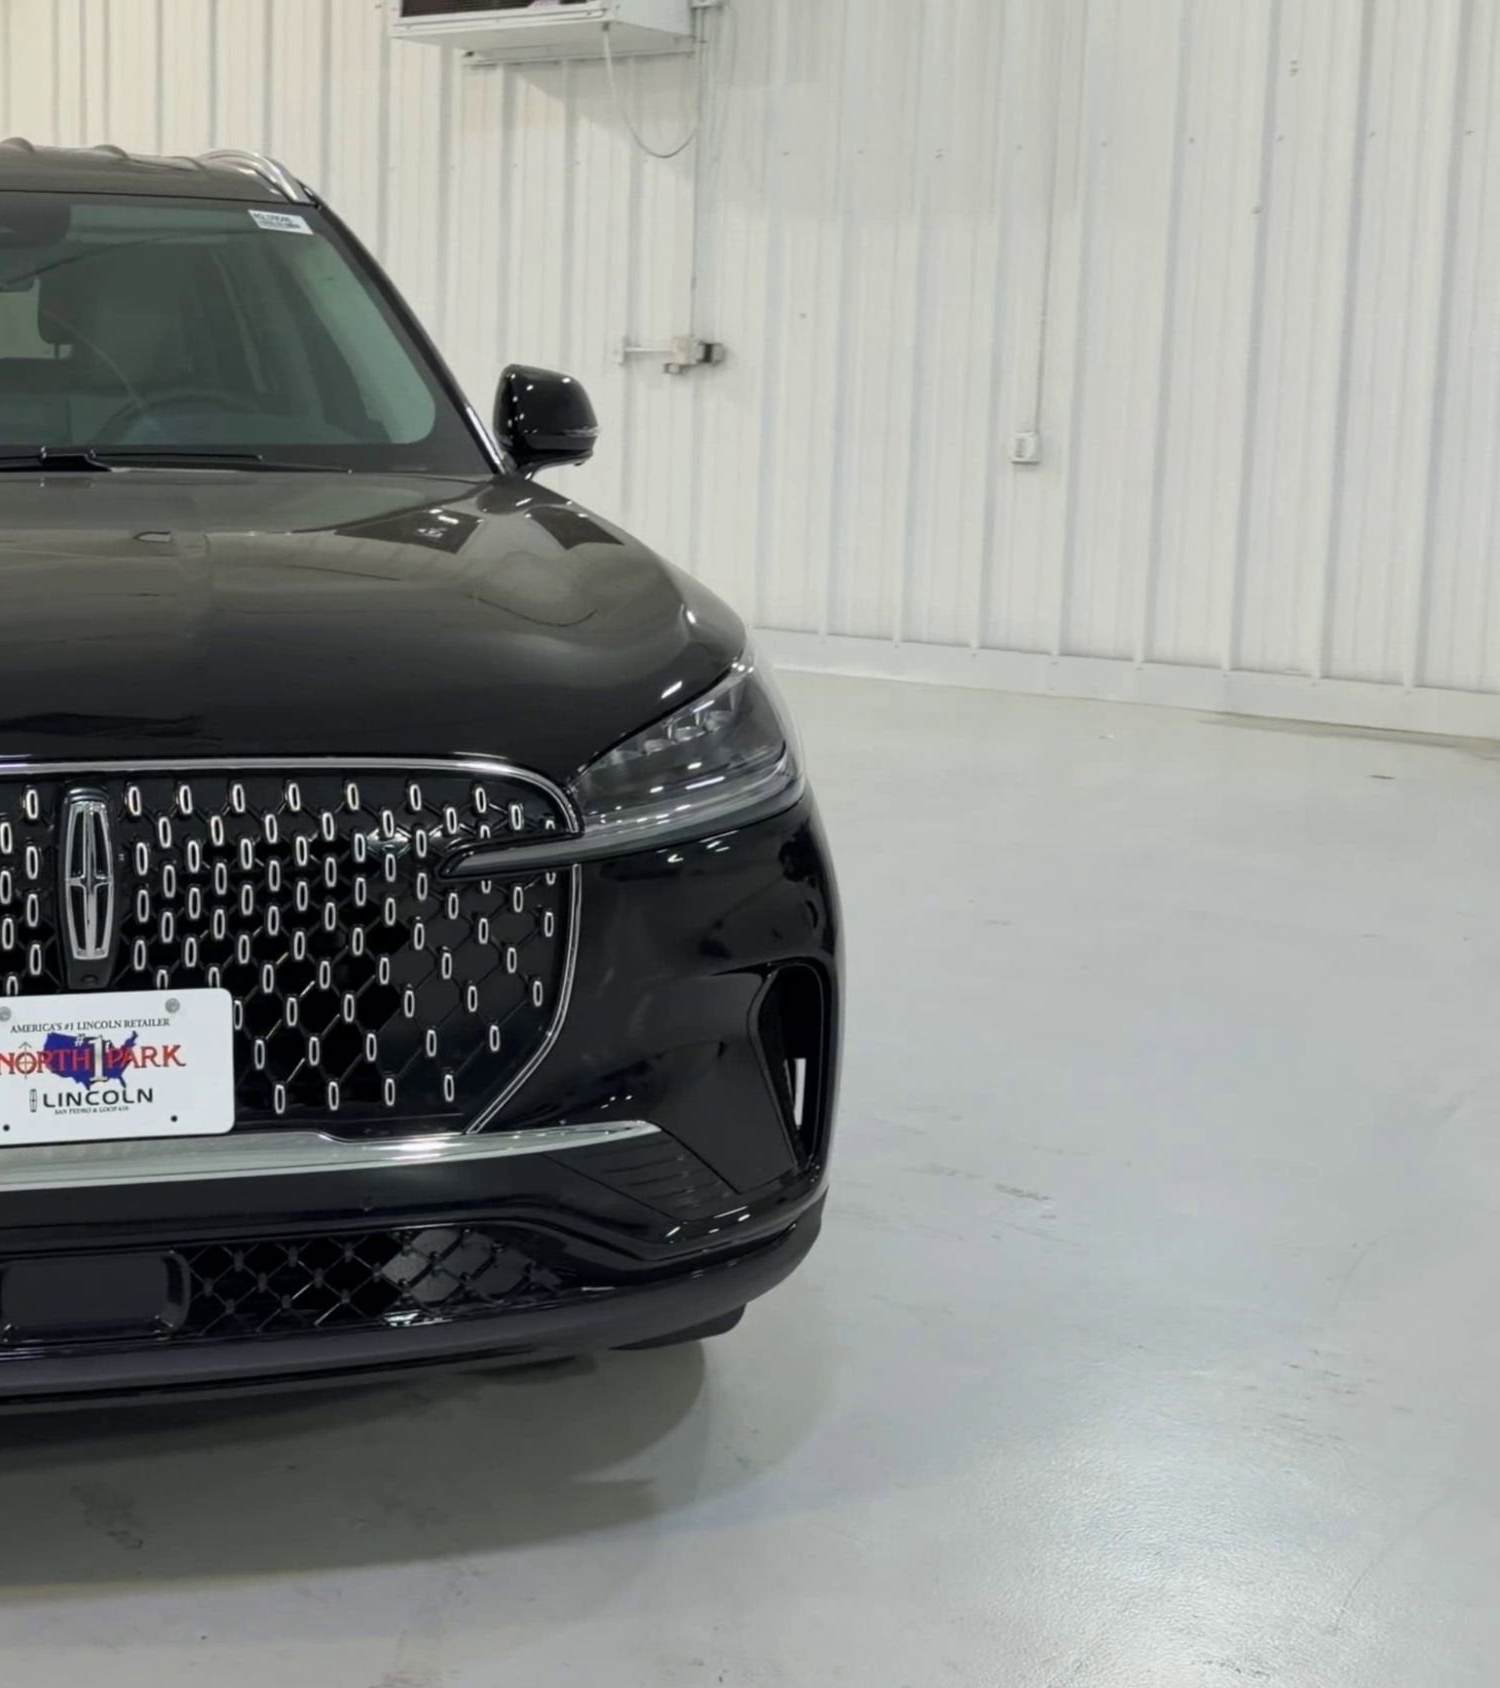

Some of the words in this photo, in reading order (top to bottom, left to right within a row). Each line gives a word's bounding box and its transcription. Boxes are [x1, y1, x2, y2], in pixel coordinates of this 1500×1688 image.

[10, 1022, 62, 1034] AMERICA'S
[64, 1022, 74, 1031] #1
[76, 1019, 122, 1031] LINCOLN
[124, 1017, 170, 1028] RETAILER
[108, 1045, 186, 1069] PARK
[43, 1087, 153, 1108] LINCOLN
